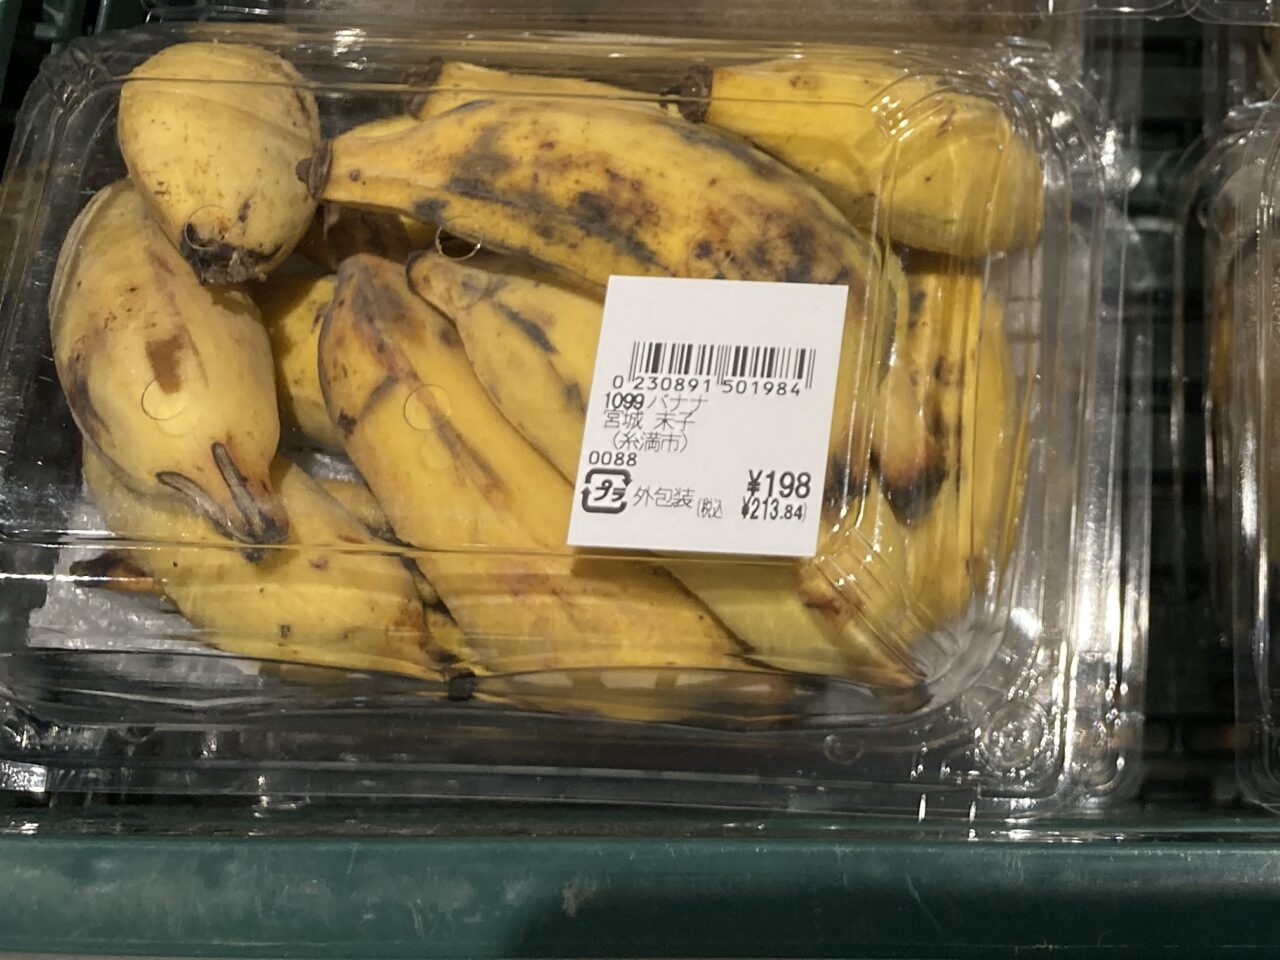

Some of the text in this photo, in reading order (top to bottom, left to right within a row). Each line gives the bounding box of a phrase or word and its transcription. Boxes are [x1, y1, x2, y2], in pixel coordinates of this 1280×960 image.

[612, 375, 801, 396] 0 230891 501984
[605, 392, 709, 412] 1099 バナナ
[604, 409, 643, 430] 宮城
[589, 451, 637, 466] 0088
[747, 469, 811, 498] ¥198
[634, 486, 695, 508] 外包装
